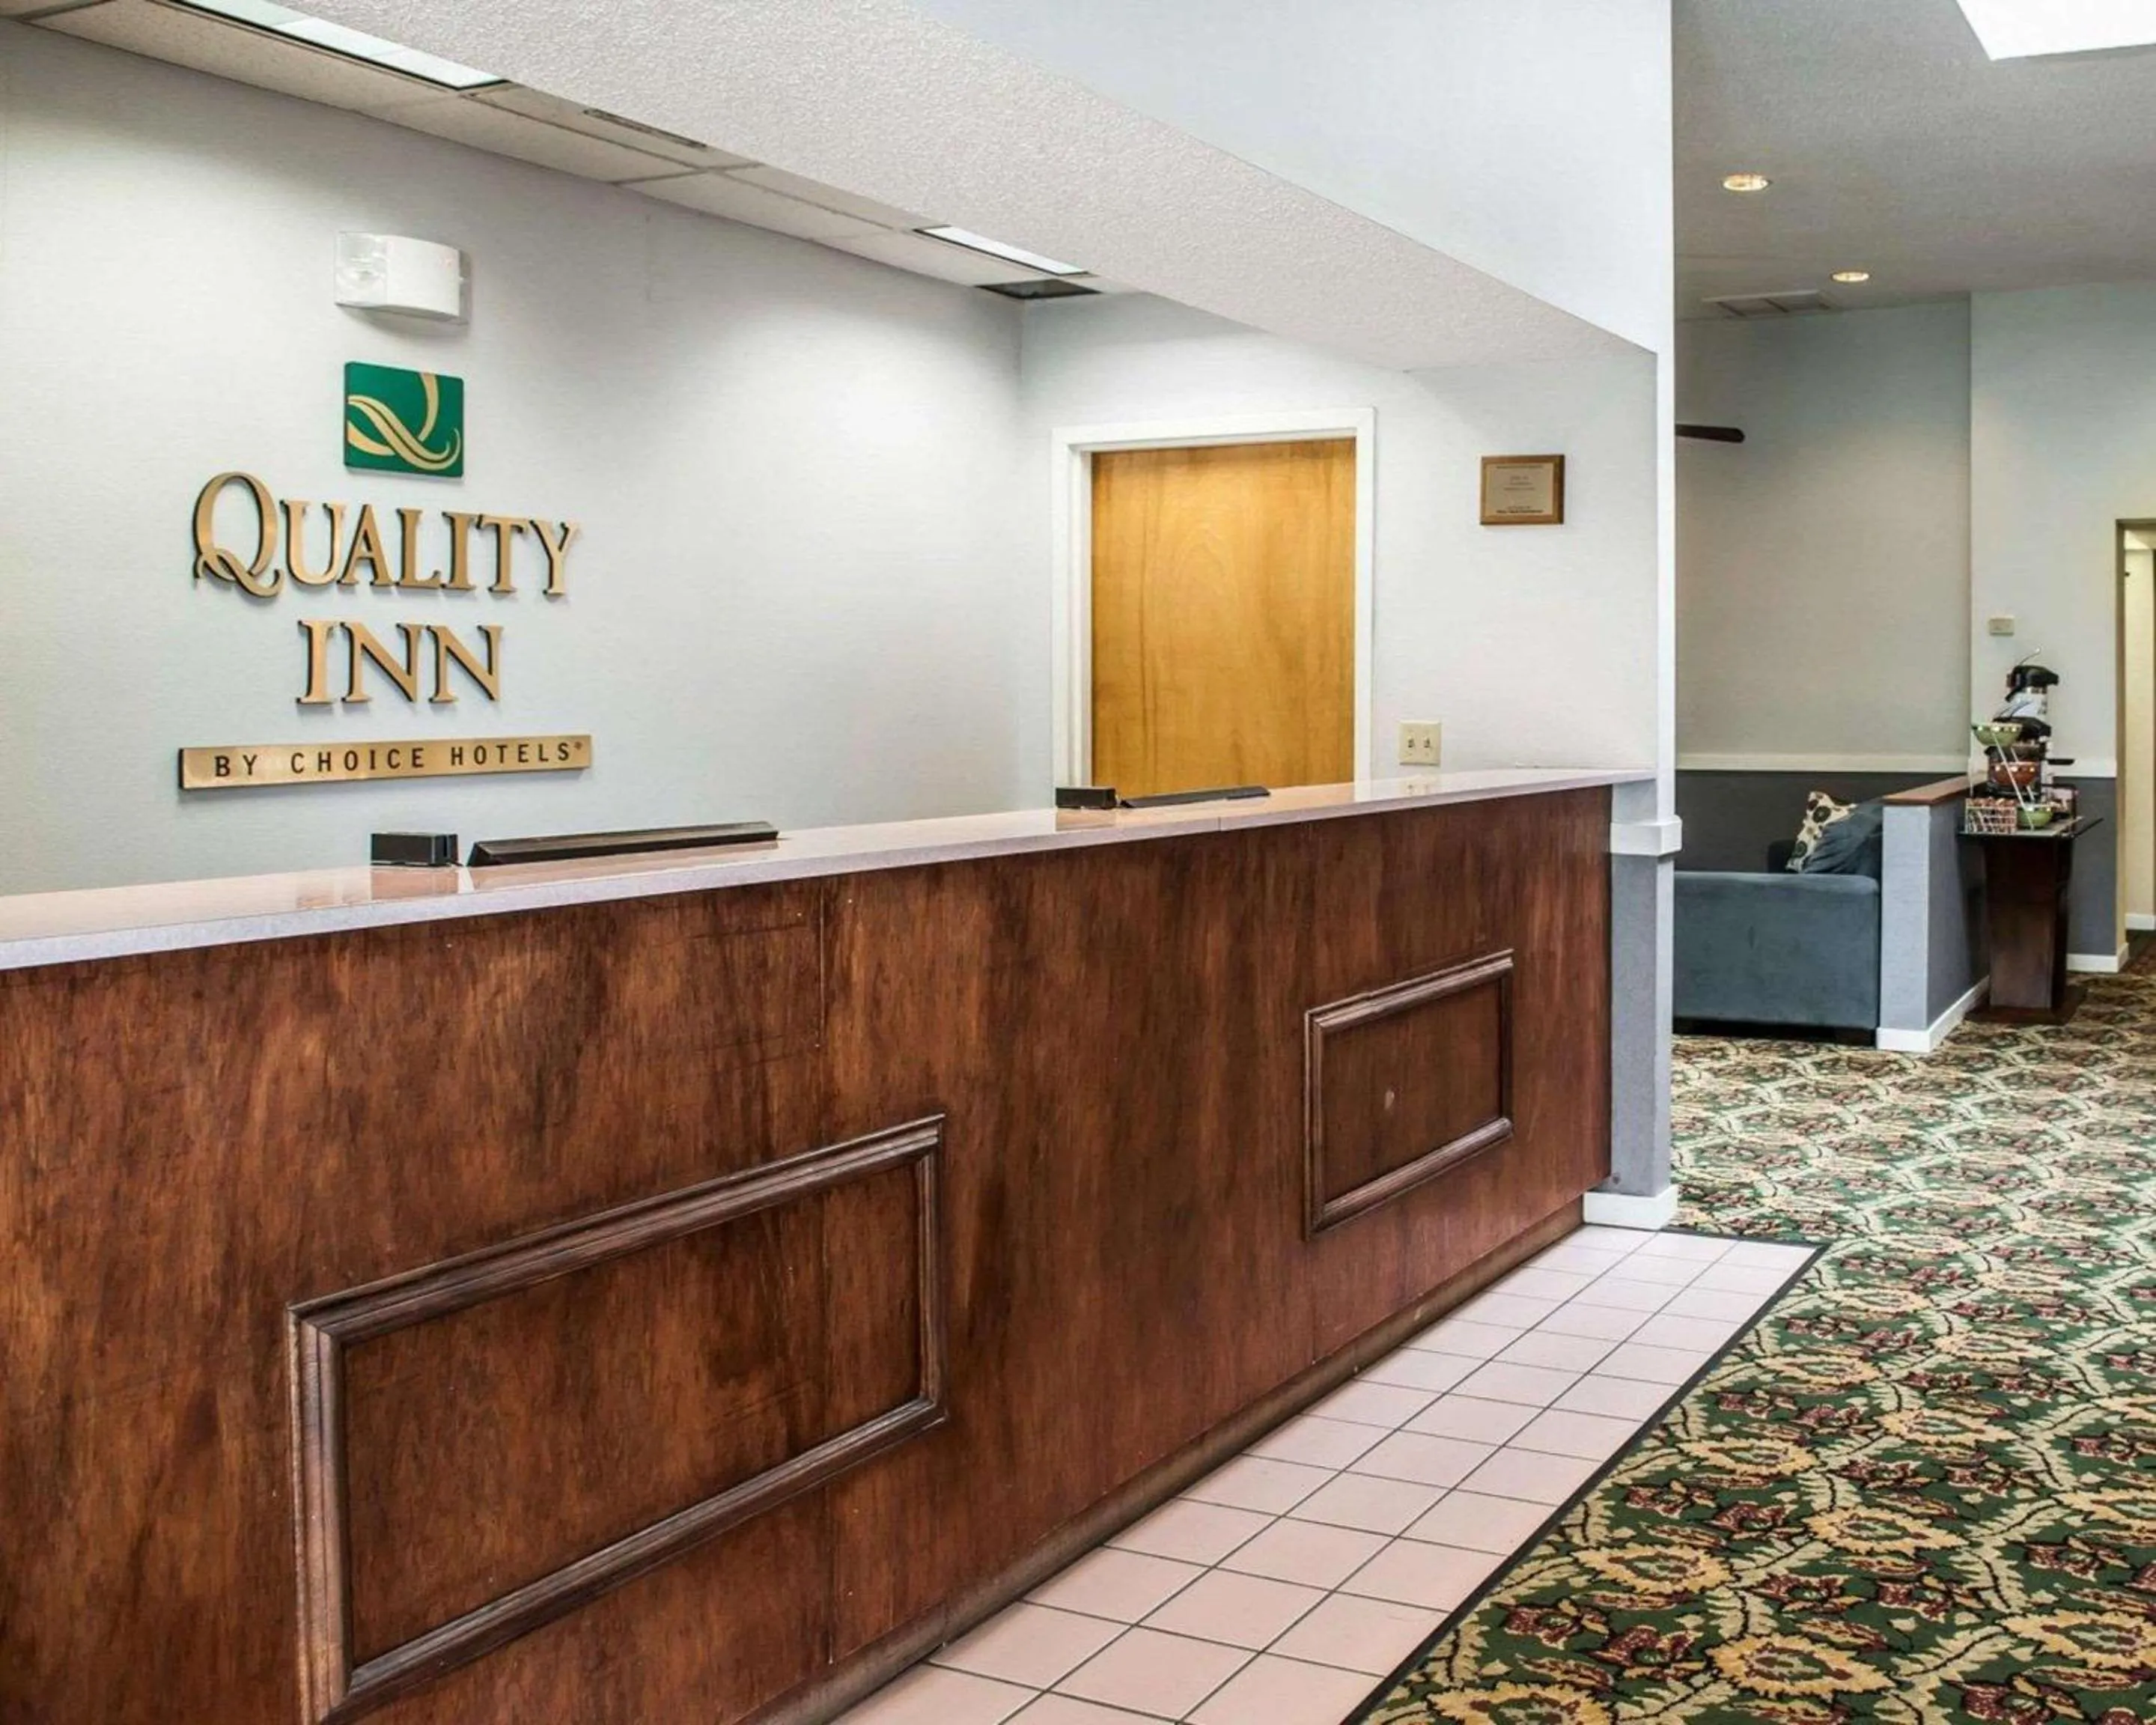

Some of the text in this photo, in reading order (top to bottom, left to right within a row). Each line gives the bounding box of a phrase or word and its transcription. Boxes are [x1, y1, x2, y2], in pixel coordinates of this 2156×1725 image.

[192, 471, 580, 598] QUALITY
[296, 620, 503, 704] INN
[214, 755, 258, 777] BY
[290, 748, 424, 774] CHOICE
